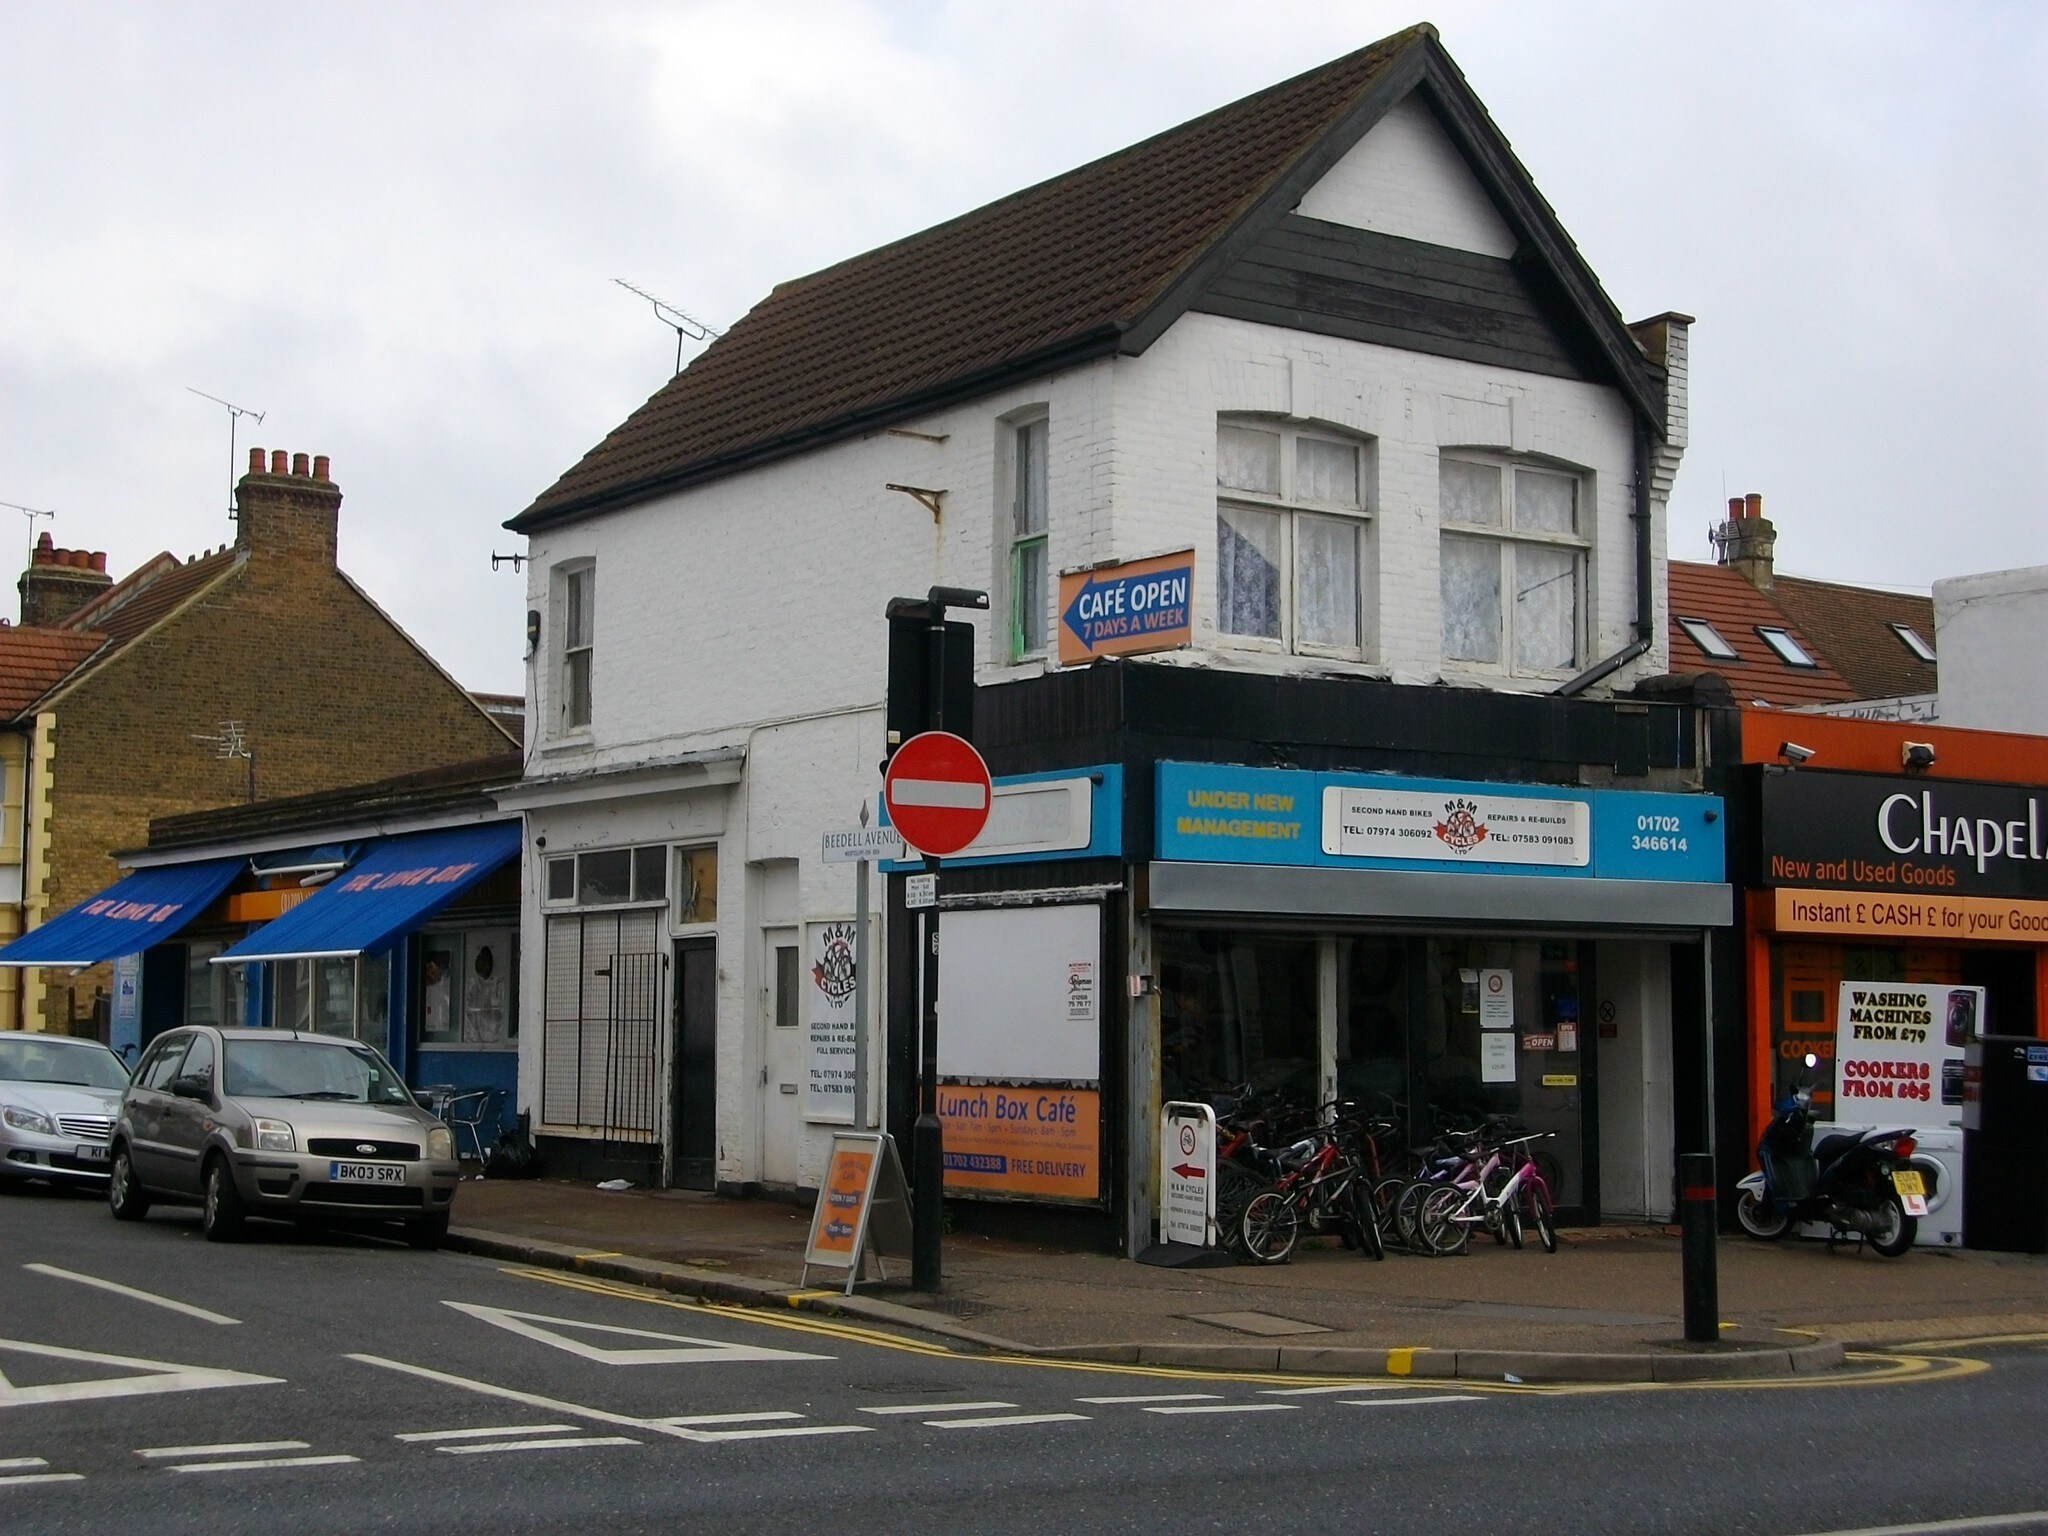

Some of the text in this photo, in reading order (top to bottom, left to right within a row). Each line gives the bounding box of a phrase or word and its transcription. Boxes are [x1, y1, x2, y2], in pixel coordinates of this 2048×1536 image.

[1079, 577, 1186, 620] CAFÉ OPEN
[1084, 608, 1184, 640] 7 DAYS A WEEK
[1188, 790, 1296, 812] UNDER NEW
[1445, 798, 1478, 815] M&M
[1352, 806, 1433, 818] SECOND HAND BIKES
[1488, 814, 1518, 823] REPAIRS
[1529, 816, 1567, 824] RE-BUILDS
[1177, 816, 1301, 840] MANAGEMENT
[1343, 826, 1432, 838] TEL: 07974 306092
[1638, 815, 1680, 832] 01702
[1878, 790, 2048, 874] CHAPEL
[825, 830, 901, 849] BEEDELL AVENUE
[1443, 834, 1479, 846] CYCLES
[1490, 833, 1574, 845] TEL: 07583 091083
[1632, 835, 1688, 852] 346614
[1772, 856, 1955, 886] New and Used Goods
[1793, 900, 1851, 924] Instant
[1857, 903, 1866, 924] £
[1872, 904, 1921, 926] CASH
[1927, 906, 1937, 927] £
[1942, 907, 1964, 928] for
[1969, 914, 2004, 934] your
[823, 922, 857, 947] M&M
[820, 976, 856, 995] CYCLES
[831, 1000, 843, 1009] LTD
[1852, 992, 1927, 1008] WASHING
[1850, 1008, 1931, 1025] MACHINES
[1532, 1038, 1554, 1047] OPEN
[1853, 1026, 1926, 1044] FROM £79
[817, 1047, 829, 1055] FULL
[1780, 1040, 1834, 1060] COOKE
[810, 1070, 822, 1078] TEL:
[824, 1070, 842, 1079] 07974
[1844, 1060, 1930, 1080] COOKERS
[810, 1084, 822, 1093] TEL:
[824, 1084, 843, 1094] 07583
[1842, 1080, 1931, 1102] FROM £65
[939, 1092, 1076, 1124] Lunch Box Café
[943, 1154, 969, 1167] 01702
[1012, 1159, 1086, 1178] FREE DELIVERY
[341, 1165, 402, 1181] BK03 SRX
[831, 1194, 842, 1202] OPEN
[1185, 1184, 1204, 1195] CYCLES
